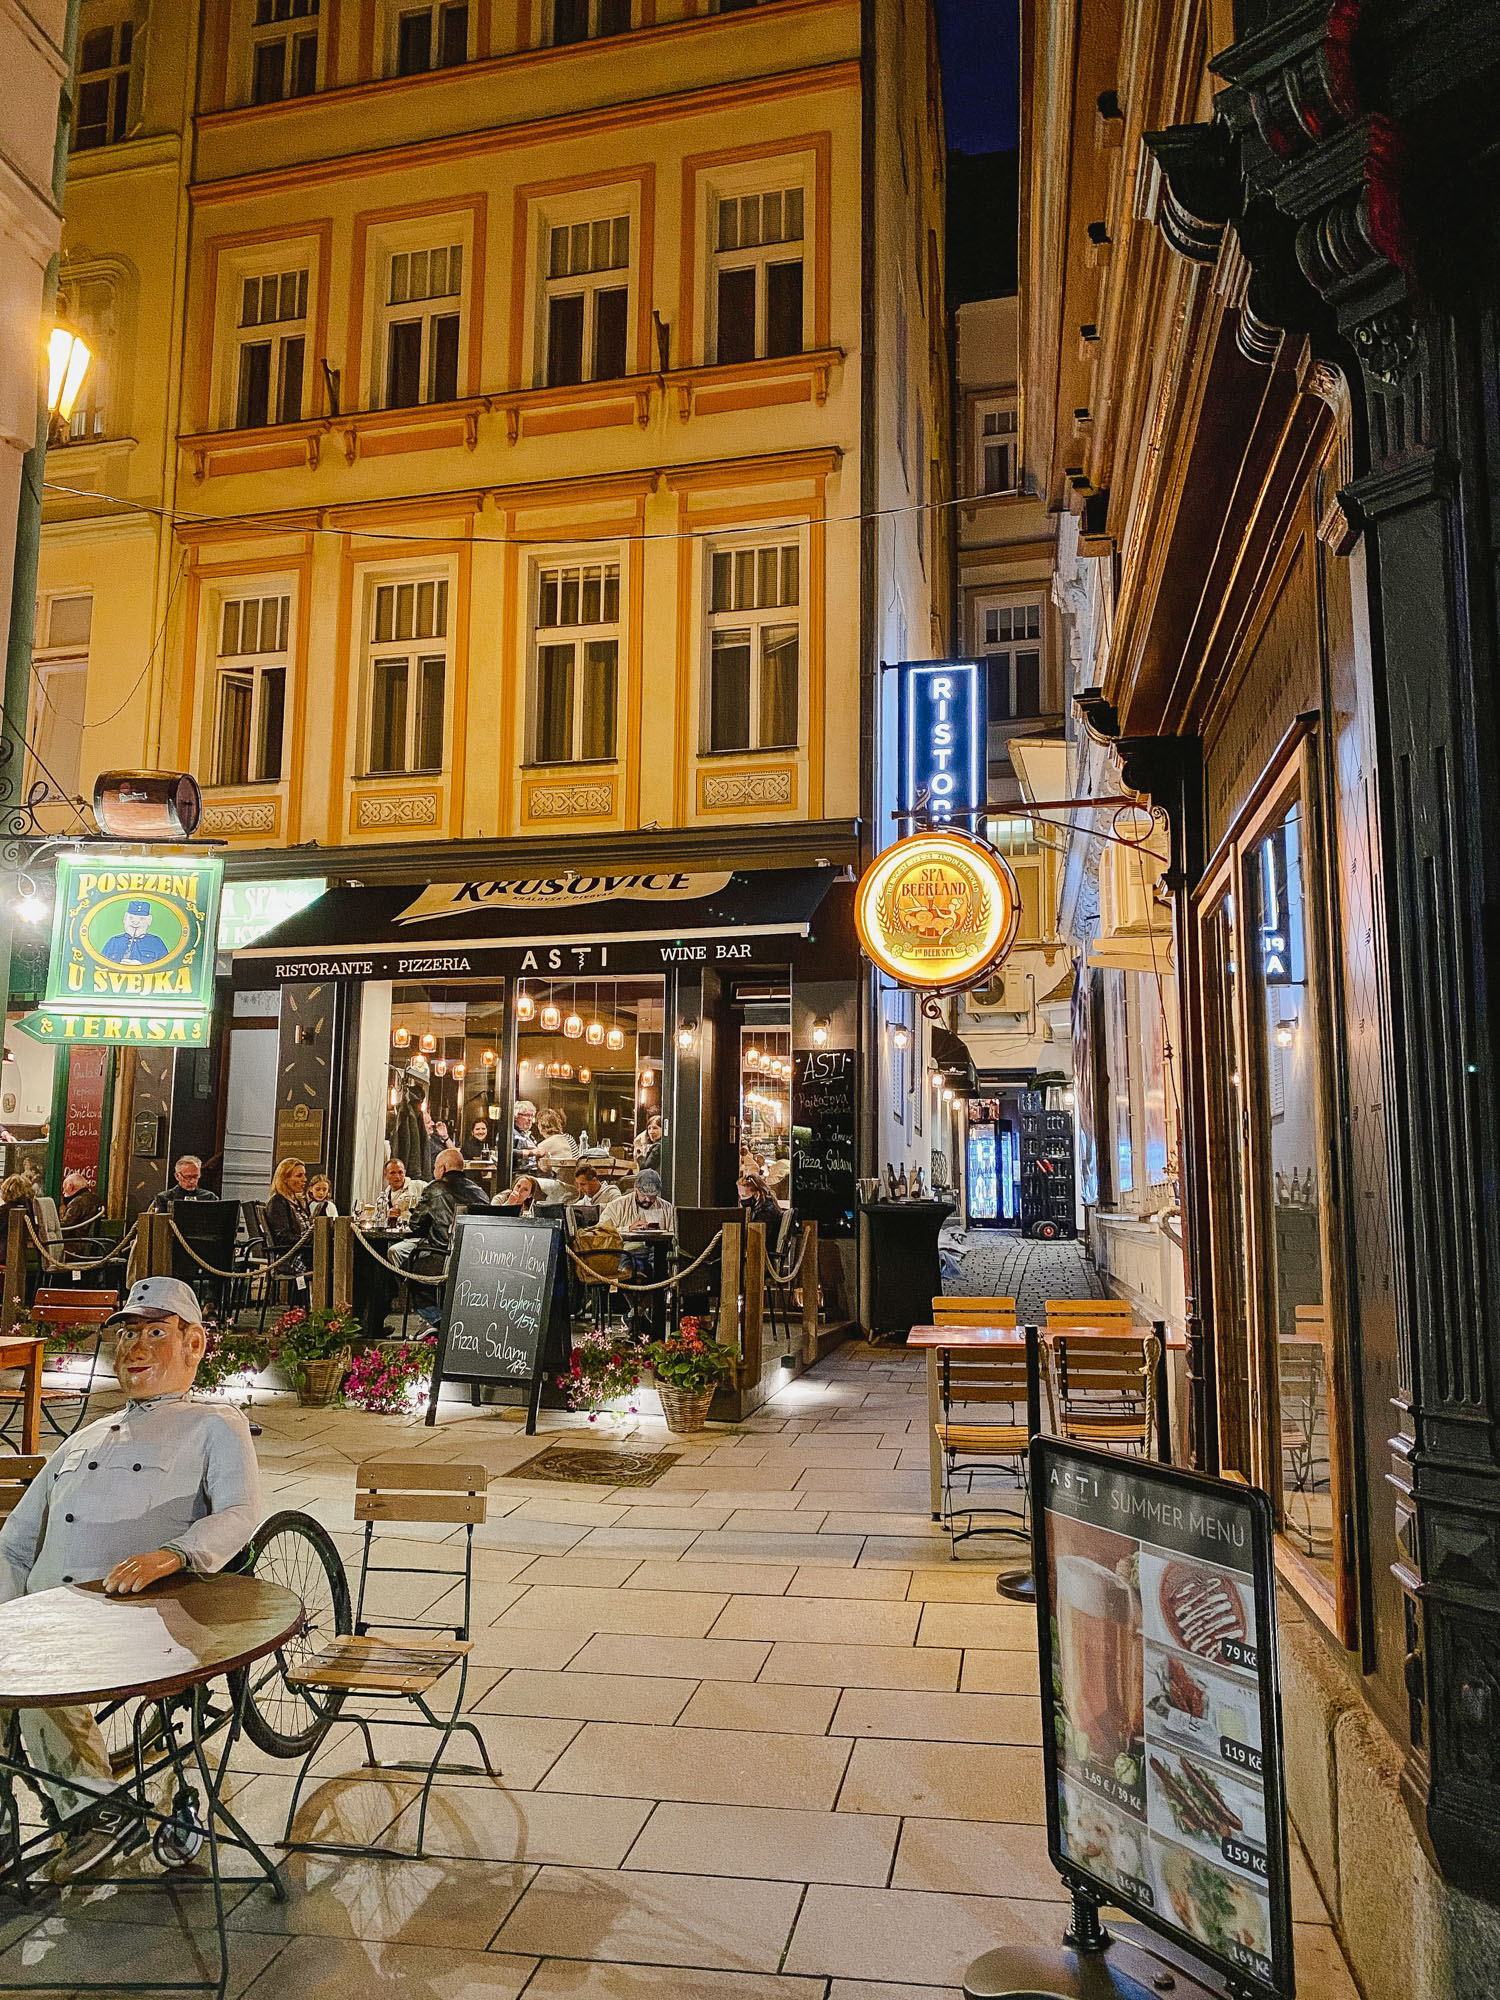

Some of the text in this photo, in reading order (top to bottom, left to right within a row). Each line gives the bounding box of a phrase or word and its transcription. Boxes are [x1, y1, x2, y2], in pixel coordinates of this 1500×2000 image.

[77, 872, 199, 904] POSEZENÍ
[922, 868, 944, 881] SPA
[902, 882, 966, 896] BEERLAND
[521, 946, 607, 971] ASTI
[660, 944, 752, 961] WINE BAR
[924, 948, 941, 957] BEER
[942, 948, 954, 957] SPA
[68, 961, 193, 997] U ŠVEJKA
[275, 957, 471, 978] RISTORANTE PIZZERIA
[61, 1015, 187, 1041] TERASA
[803, 1052, 846, 1082] ASTI
[793, 1150, 823, 1170] Pizza
[520, 1232, 546, 1276] Menu
[455, 1279, 489, 1308] Pizza
[450, 1321, 527, 1361] Pizza Salami
[1049, 1468, 1245, 1548] ASTI SUMMER MENU
[1226, 1644, 1257, 1667] 79 Kč
[1225, 1743, 1262, 1771] 119 Kč
[1226, 1844, 1267, 1874] 159 Kč
